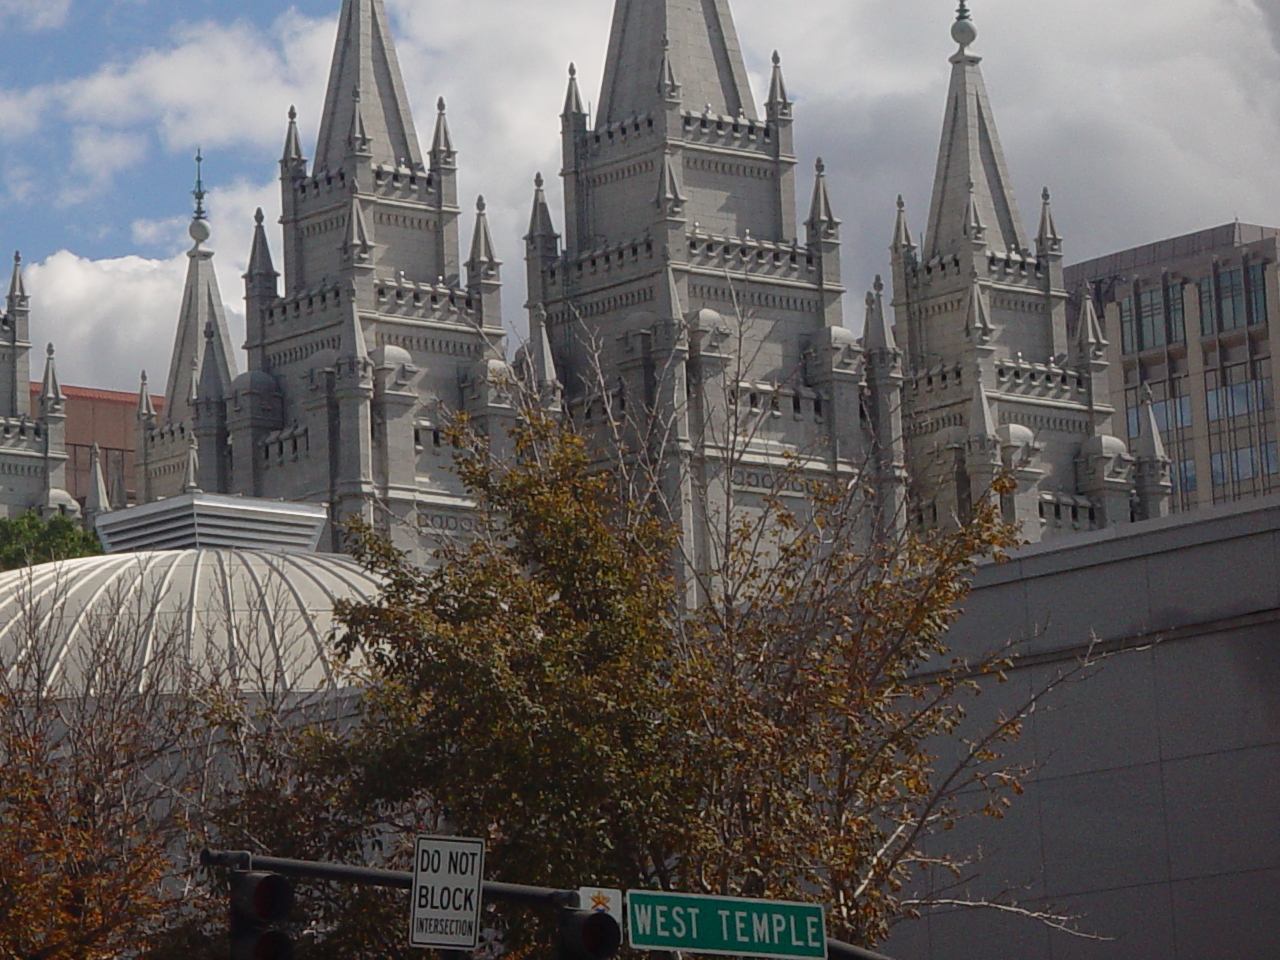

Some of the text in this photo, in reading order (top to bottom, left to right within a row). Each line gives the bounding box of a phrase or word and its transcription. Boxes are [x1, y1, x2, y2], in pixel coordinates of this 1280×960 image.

[420, 848, 478, 876] DO NOT
[418, 885, 475, 912] BLOCK
[416, 917, 474, 937] INTERSECTION
[634, 903, 821, 948] WEST TEMPLE
